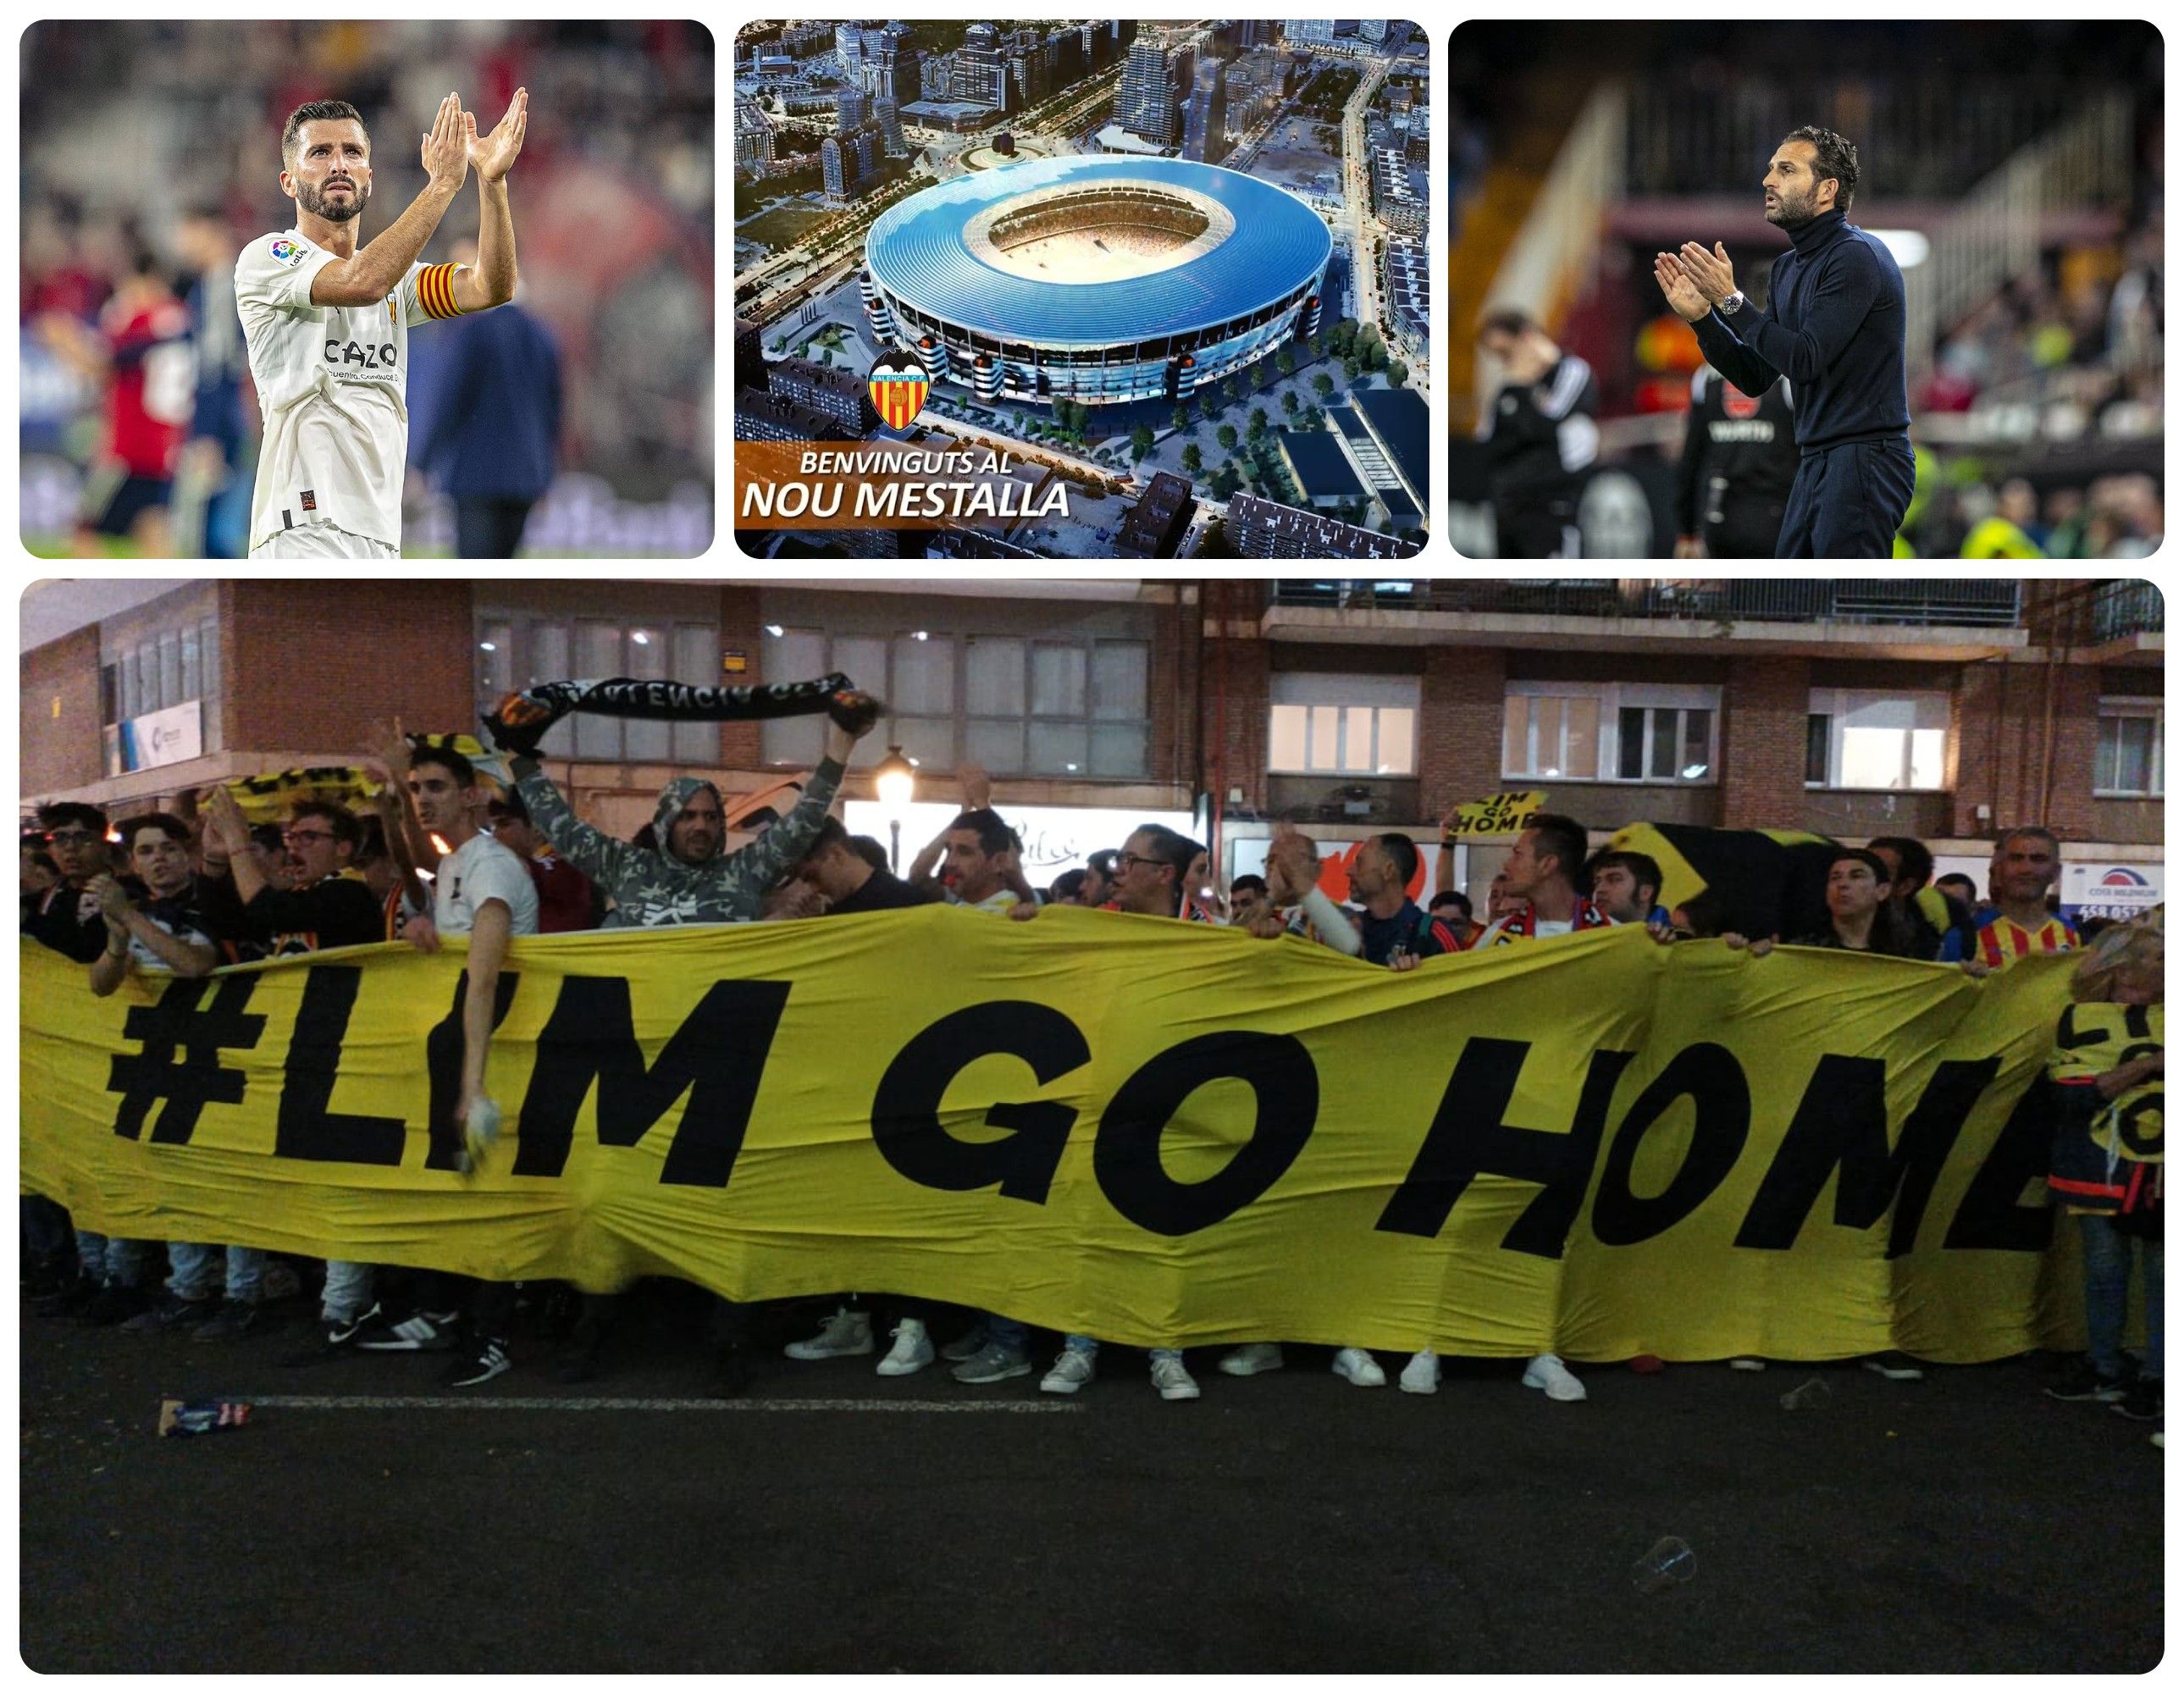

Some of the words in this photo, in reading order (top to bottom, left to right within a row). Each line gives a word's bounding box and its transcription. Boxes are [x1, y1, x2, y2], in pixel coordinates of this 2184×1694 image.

[1484, 807, 1512, 818] GO
[106, 965, 793, 1188] #LIM
[871, 999, 1319, 1237] GO
